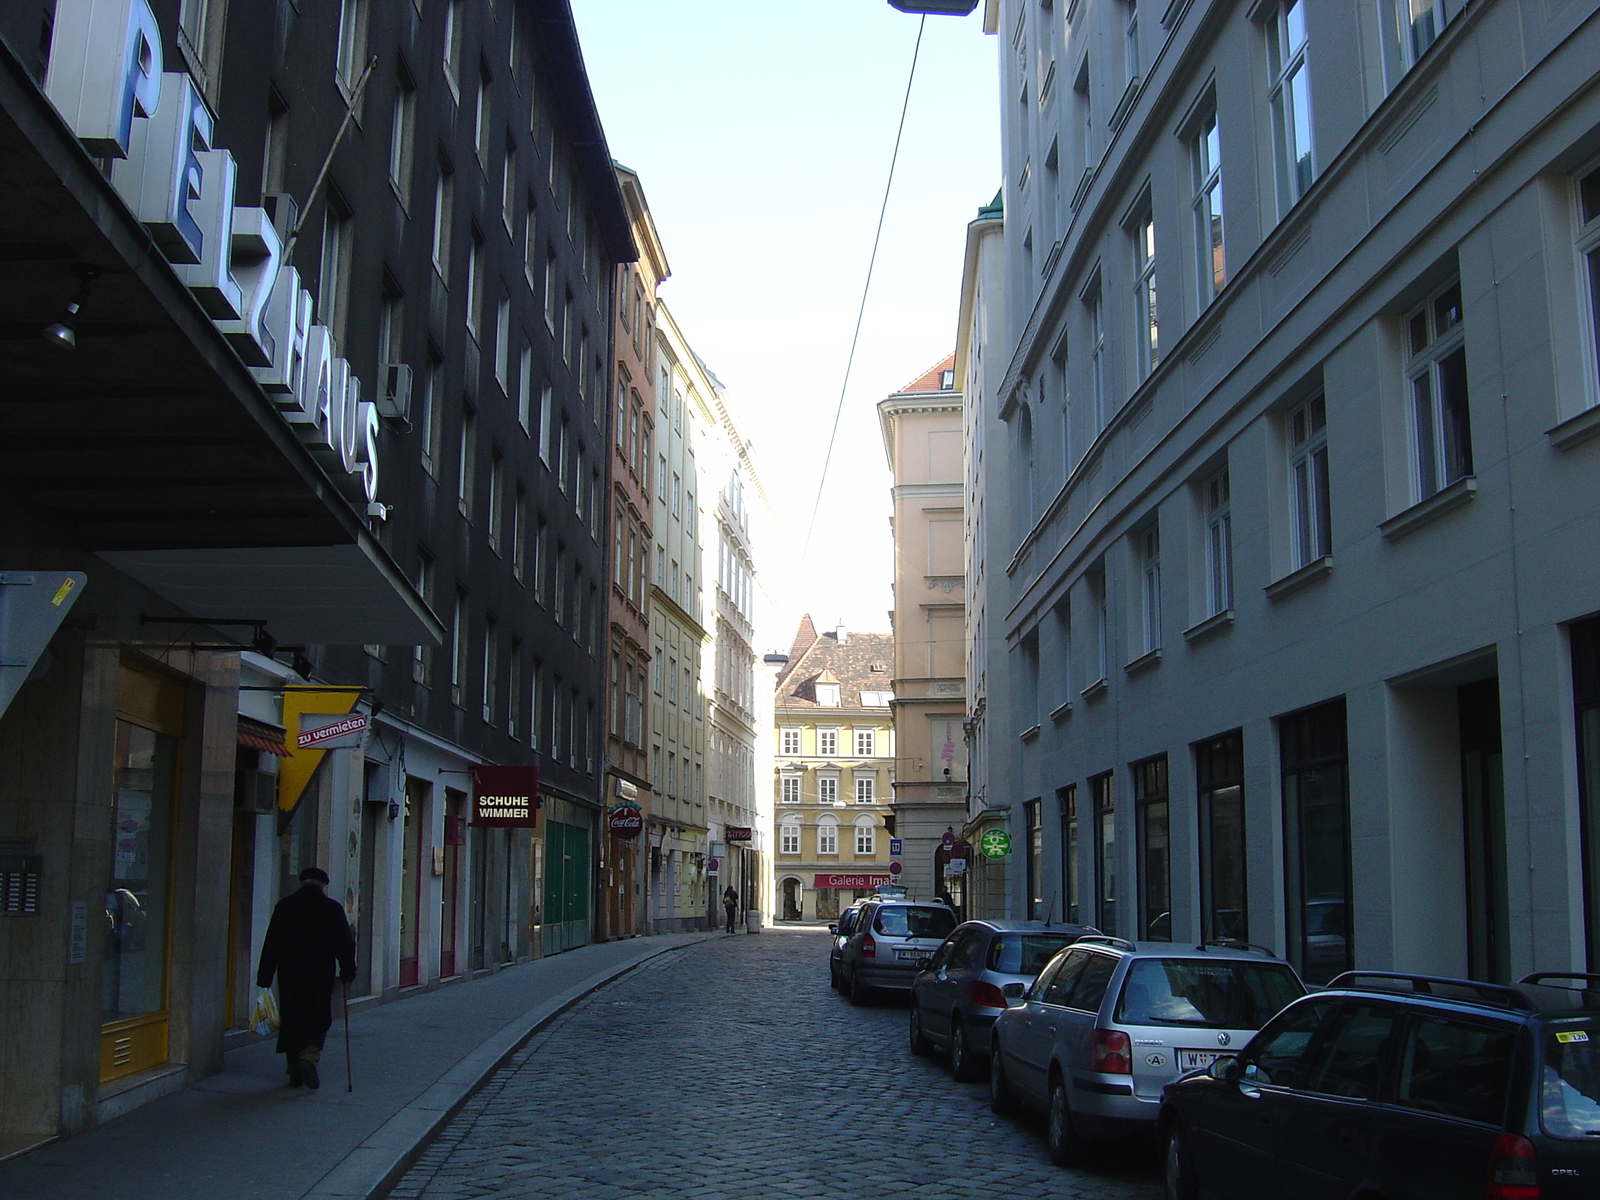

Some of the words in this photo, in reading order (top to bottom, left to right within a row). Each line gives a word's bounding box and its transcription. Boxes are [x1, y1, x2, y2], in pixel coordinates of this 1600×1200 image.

[313, 719, 365, 740] vermieten
[479, 796, 529, 806] SCHUHE
[479, 808, 529, 818] WIMMER
[828, 875, 864, 886] Galerie
[1551, 1168, 1580, 1177] OPEL
